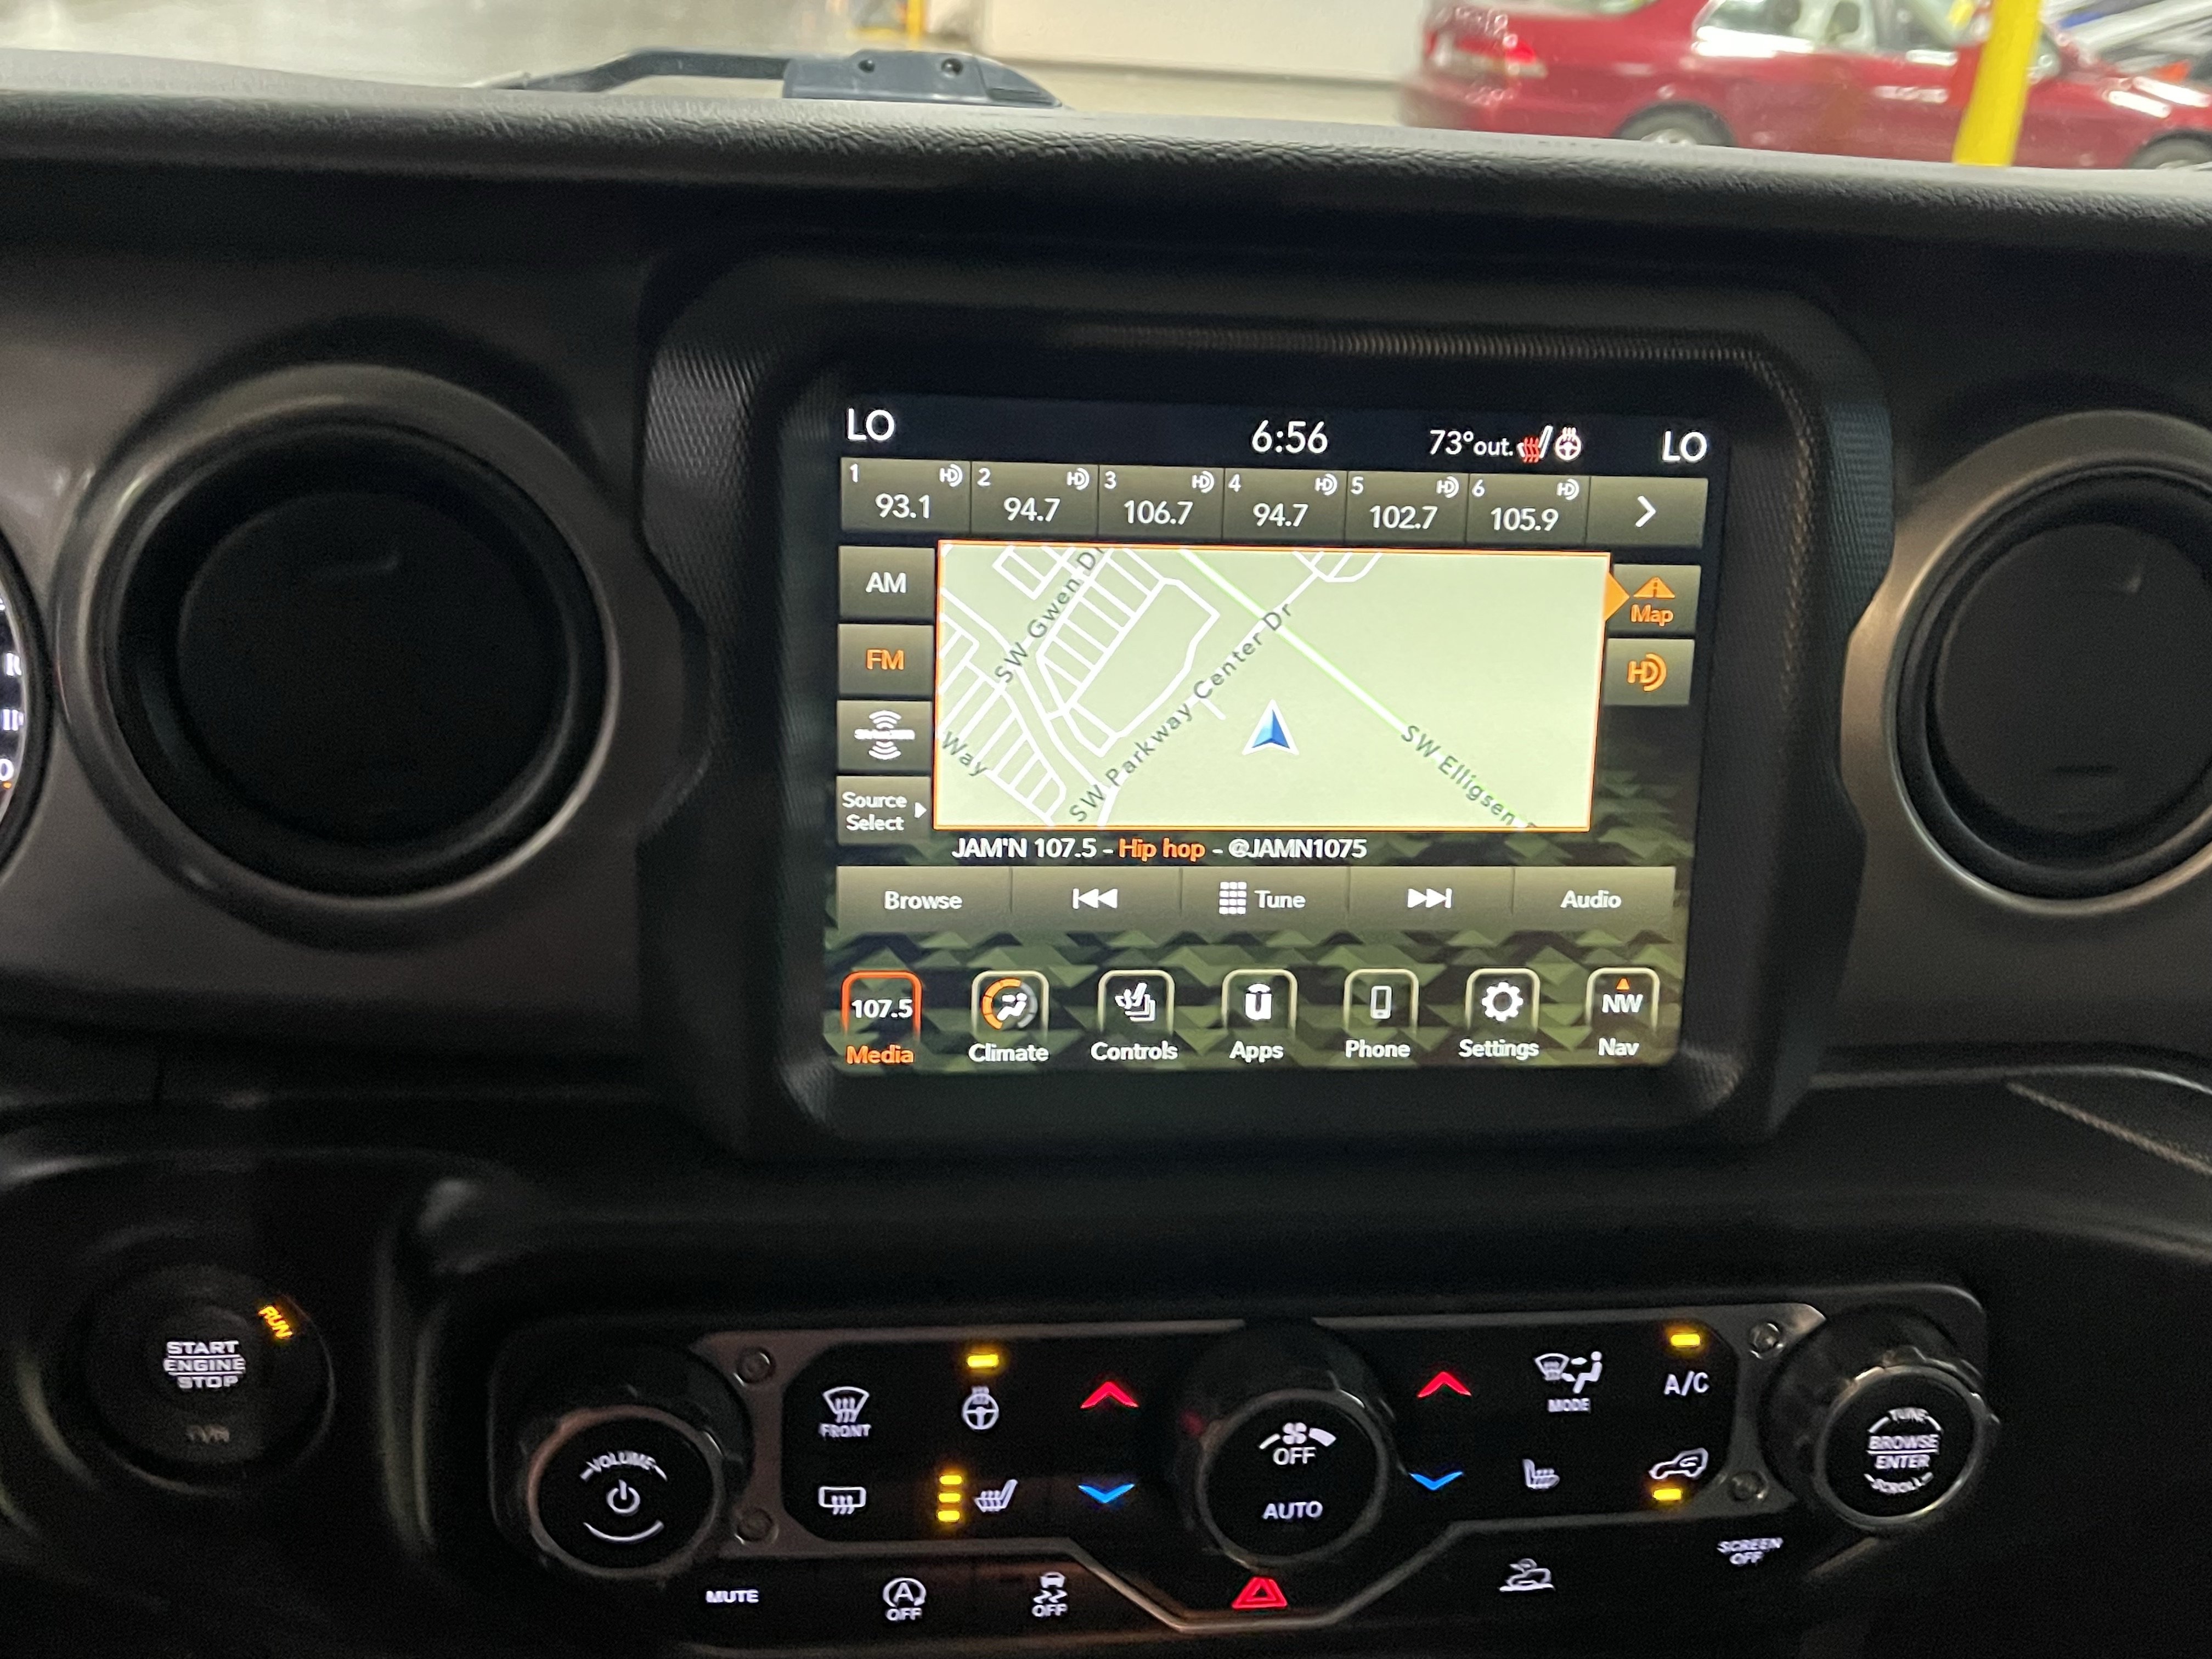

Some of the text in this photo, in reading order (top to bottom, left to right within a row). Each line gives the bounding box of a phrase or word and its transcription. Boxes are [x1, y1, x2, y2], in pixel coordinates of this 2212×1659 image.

[847, 408, 896, 441] LO
[1251, 420, 1328, 454] 6:56
[1662, 431, 1708, 463] LO
[850, 464, 859, 482] 1
[977, 469, 991, 487] 2
[1104, 471, 1117, 489] 3
[1228, 475, 1241, 492] 4
[1350, 477, 1364, 494] 5
[1471, 480, 1485, 498] 6
[875, 494, 930, 518] 93.1
[1003, 498, 1060, 522] 94.7
[1123, 500, 1193, 525] 106.7
[1252, 503, 1309, 527] 94.7
[1369, 505, 1438, 530] 102.7
[1491, 507, 1559, 532] 105.9
[866, 572, 906, 594] AM
[1630, 605, 1673, 627] Map
[994, 642, 1029, 684] SW
[1026, 579, 1080, 640] Gwen
[865, 648, 905, 670] FM
[1069, 602, 1293, 822] SW Parkway Center Dr
[942, 731, 989, 777] Way
[1401, 725, 1516, 827] SW Elligsen
[842, 792, 907, 809] Source
[845, 814, 904, 832] Select
[952, 837, 1027, 859] JAM'N
[1034, 838, 1098, 858] 107.5
[1118, 837, 1157, 862] Hip
[1162, 838, 1206, 862] hop
[1228, 838, 1368, 860] @JAMN1075
[884, 890, 963, 910] Browse
[1255, 890, 1306, 909] Tune
[1560, 890, 1621, 910] Audio
[851, 998, 913, 1019] 107.5
[1601, 994, 1644, 1014] NW
[845, 1045, 915, 1065] Media
[968, 1043, 1049, 1063] Climate
[1090, 1041, 1178, 1061] Controls
[1229, 1041, 1284, 1062] Apps
[1345, 1039, 1411, 1058] Phone
[1458, 1038, 1539, 1060] Settings
[1598, 1038, 1639, 1057] Nav
[258, 1305, 293, 1339] RUN
[166, 1340, 239, 1355] START
[164, 1357, 246, 1372] ENGINE
[177, 1375, 239, 1389] STOP
[1663, 1371, 1709, 1397] A/C
[1547, 1397, 1591, 1413] MODE
[819, 1424, 871, 1438] FRONT
[1868, 1434, 1941, 1450] BROWSE
[585, 1449, 657, 1472] VOLUME
[1273, 1447, 1316, 1465] OFF
[1874, 1454, 1931, 1470] ENTER
[1262, 1501, 1323, 1519] AUTO
[1716, 1537, 1784, 1555] SCREEN
[1729, 1551, 1764, 1566] OFF
[706, 1589, 759, 1603] MUTE
[885, 1607, 923, 1621] OFF
[1032, 1603, 1068, 1617] OFF
